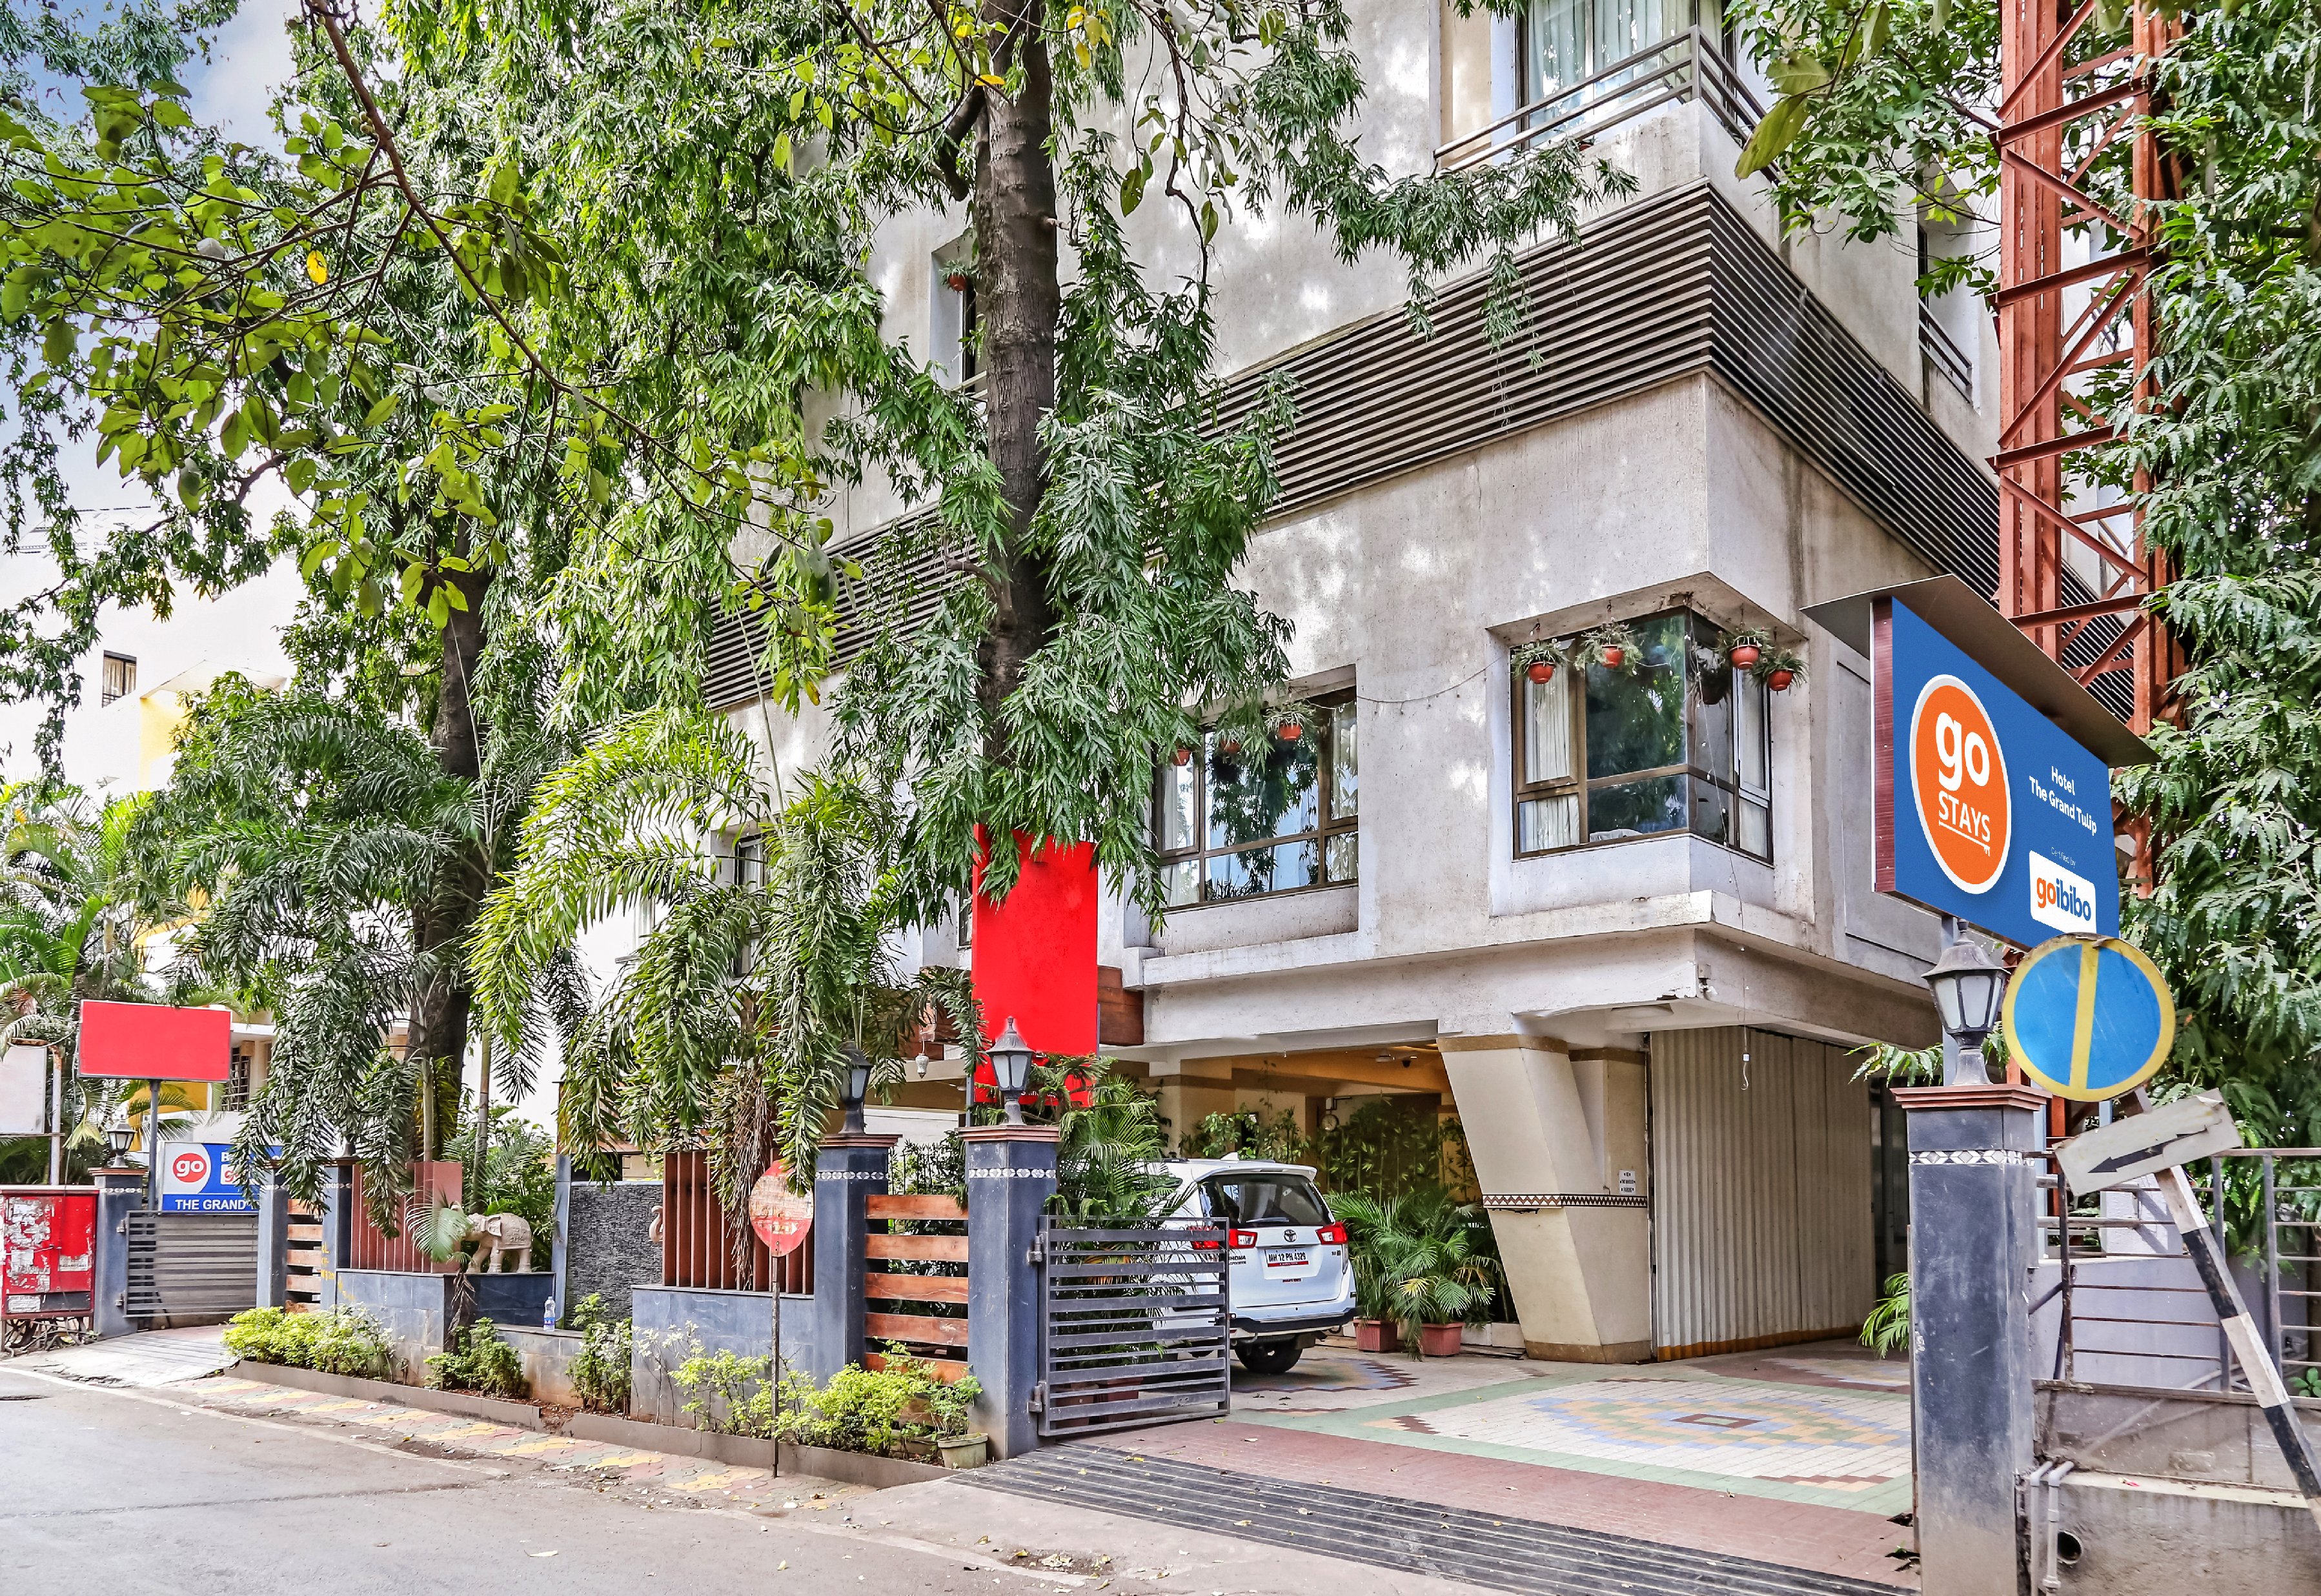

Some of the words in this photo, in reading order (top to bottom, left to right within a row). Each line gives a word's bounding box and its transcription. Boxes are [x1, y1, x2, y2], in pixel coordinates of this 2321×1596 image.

[1935, 712, 1990, 791] go
[2051, 765, 2076, 796] Hotel
[1938, 790, 1991, 842] STAYS
[2029, 775, 2047, 802] The
[2049, 790, 2075, 820] Grand
[2076, 807, 2097, 836] Tulip
[2051, 847, 2070, 864] Certified
[2070, 856, 2076, 868] by
[2036, 877, 2092, 922] goibibo
[176, 1159, 204, 1177] go
[175, 1198, 199, 1210] THE
[203, 1199, 247, 1211] GRAND
